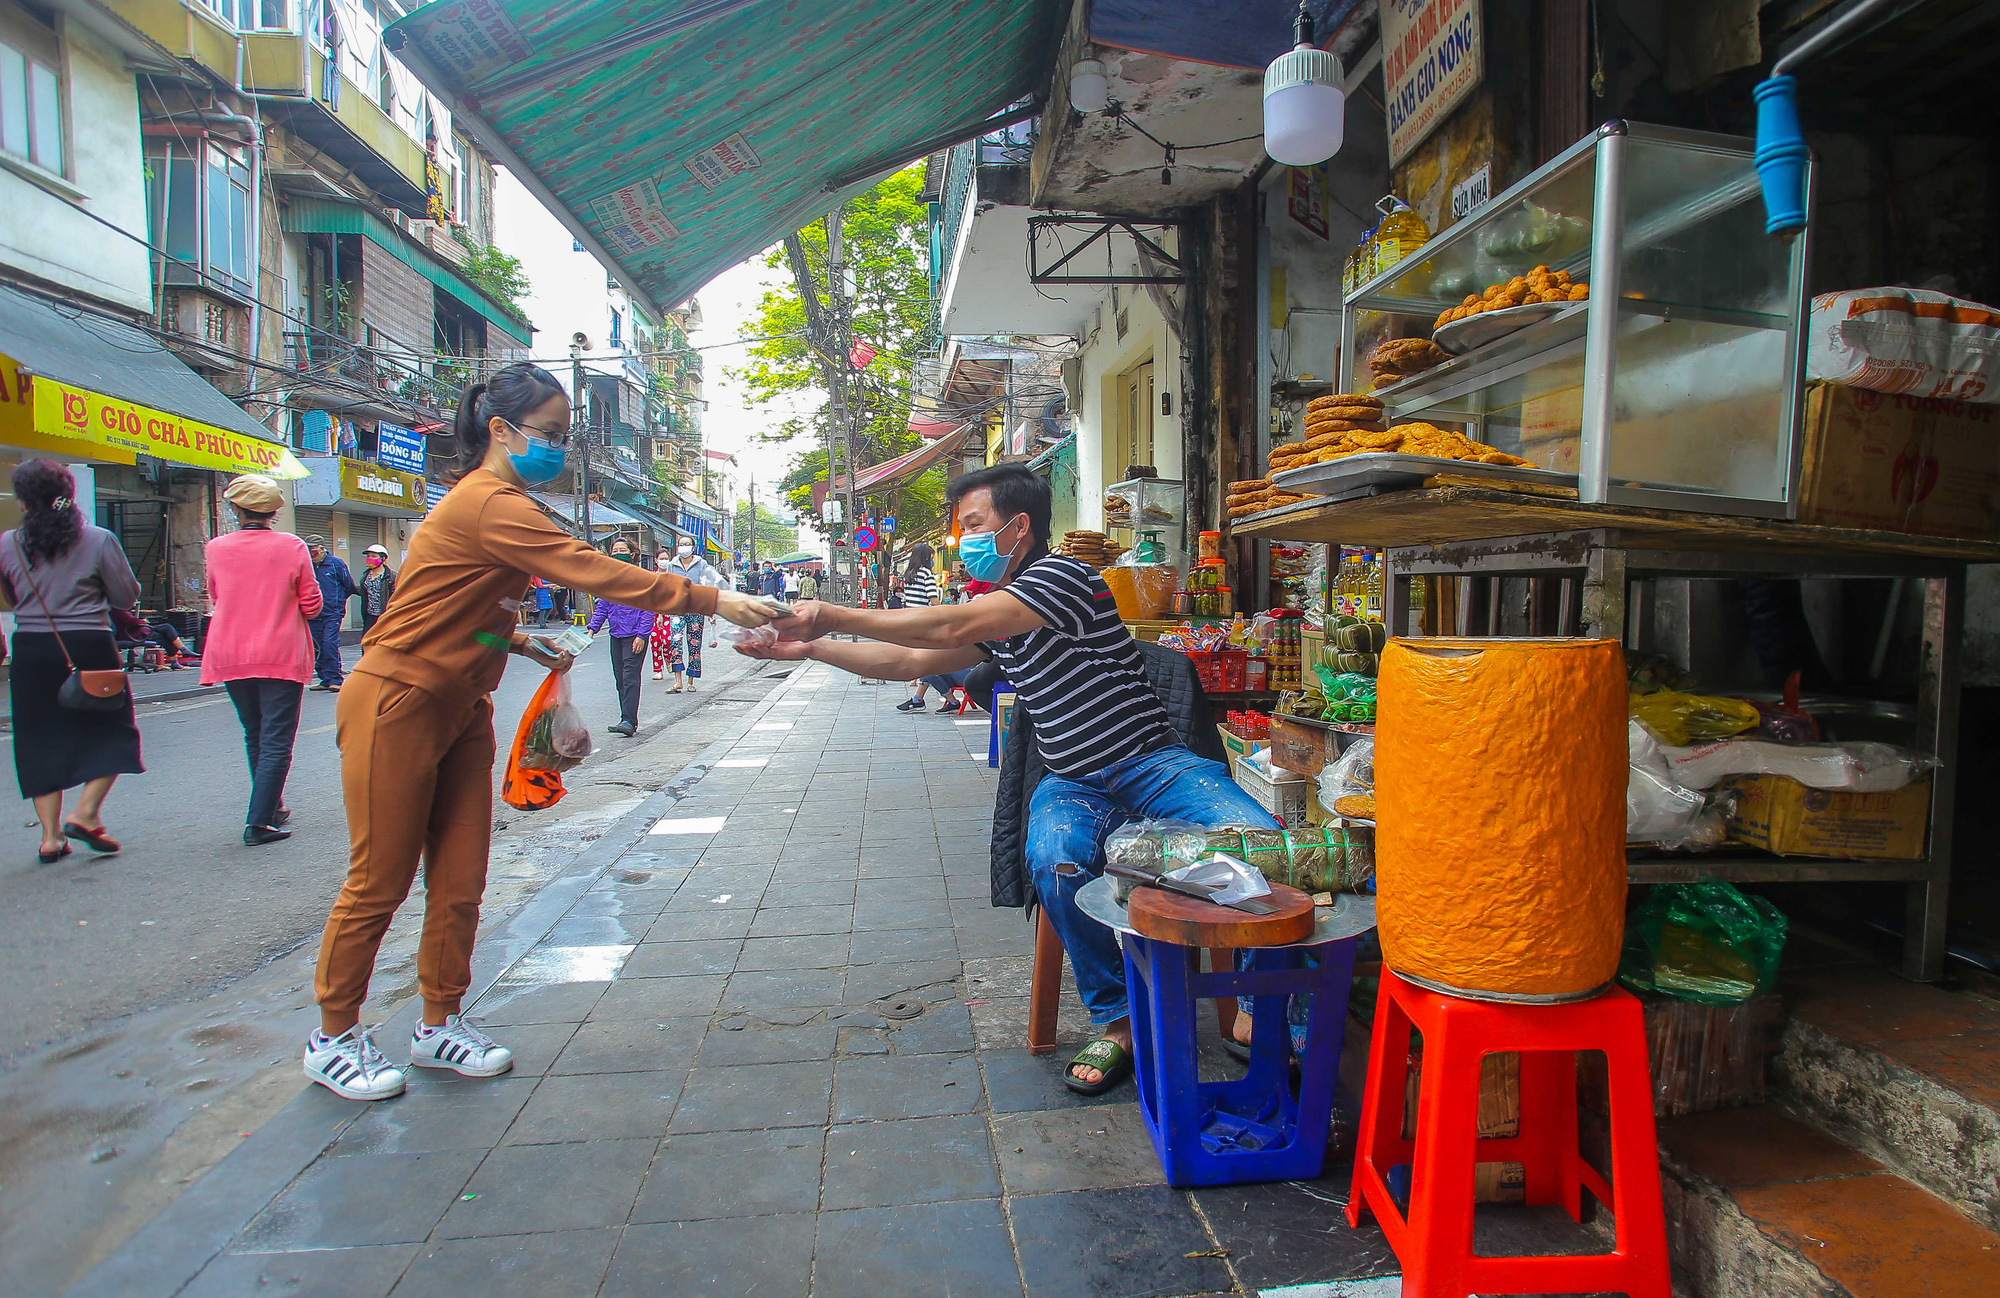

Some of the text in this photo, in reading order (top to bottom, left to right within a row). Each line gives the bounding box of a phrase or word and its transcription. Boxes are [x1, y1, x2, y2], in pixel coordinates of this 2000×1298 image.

[1389, 86, 1416, 136] BÁNH
[1418, 46, 1436, 104] GIÒ
[1438, 11, 1472, 83] NÓNG
[1453, 172, 1488, 217] SỬA NHÀ
[101, 406, 280, 469] GIÒ CHẢ PHÚC LỘC
[381, 439, 409, 458] ĐỒNG
